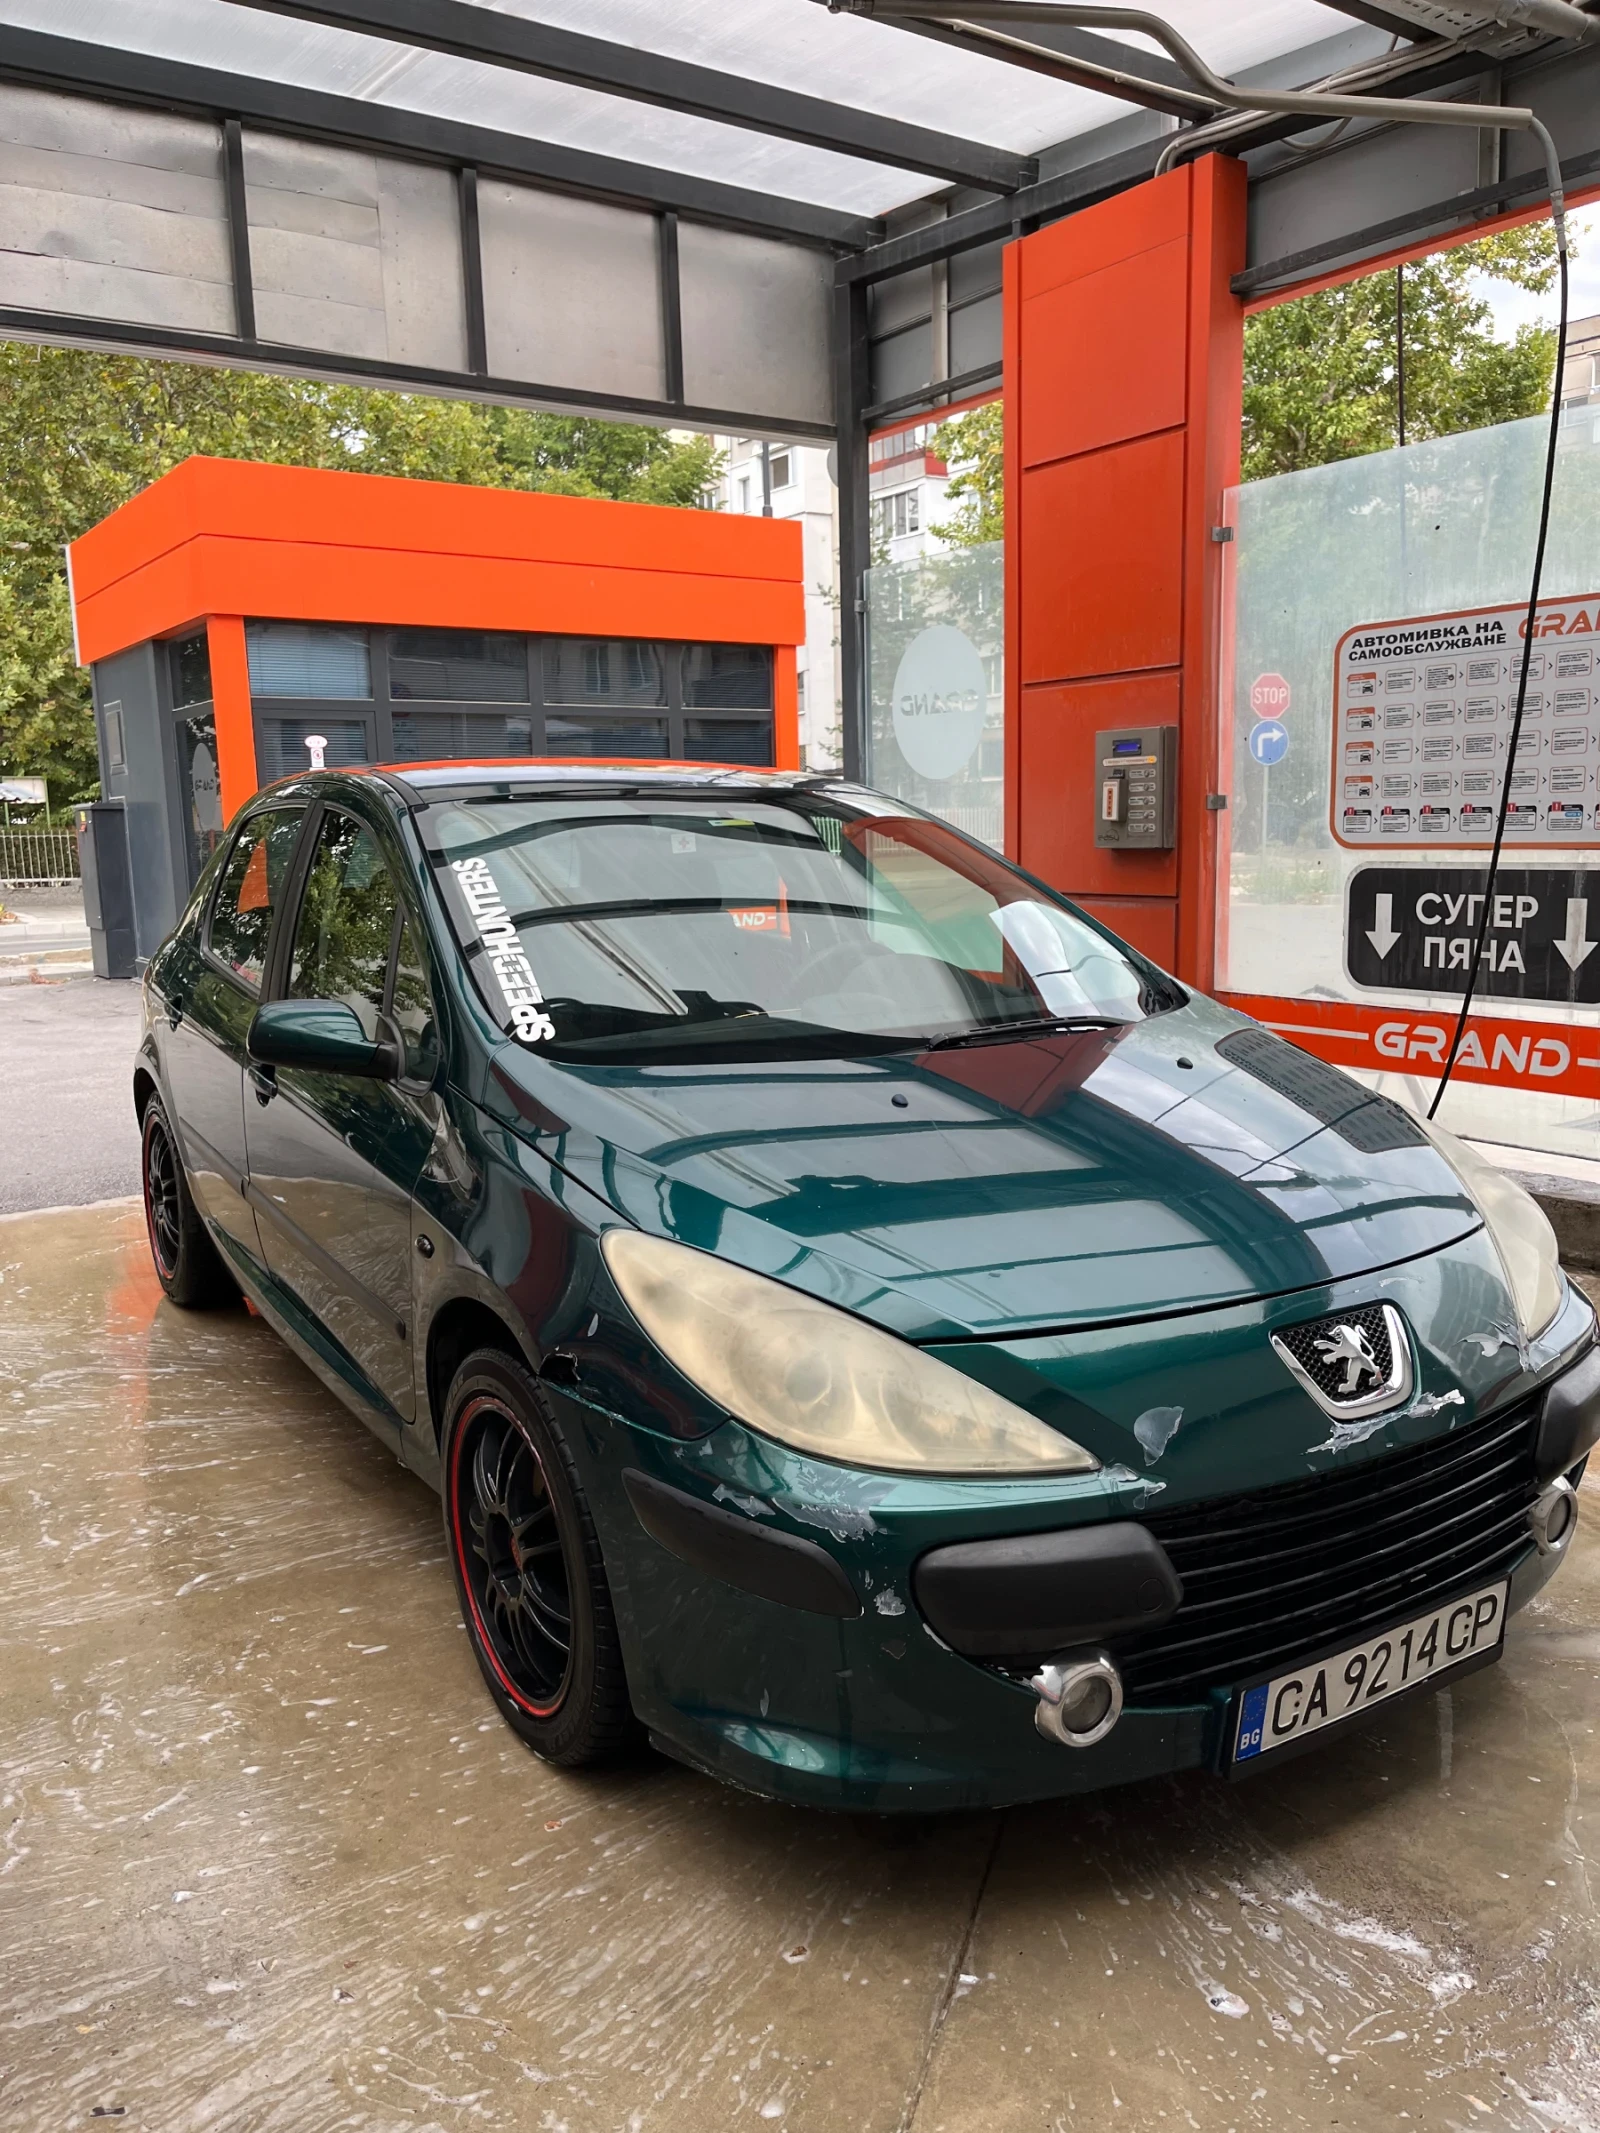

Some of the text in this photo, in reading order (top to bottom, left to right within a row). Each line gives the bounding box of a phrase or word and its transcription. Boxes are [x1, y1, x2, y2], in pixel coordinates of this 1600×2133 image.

[1351, 621, 1503, 649] АВТОМИВКА НА
[1518, 609, 1600, 639] GRA
[1348, 633, 1506, 661] САМООБСЛУЖВАНЕ
[1254, 687, 1287, 704] STOP
[1415, 892, 1539, 929] СУПЕР
[452, 857, 556, 1042] SPEEDHUNTERS
[1423, 936, 1527, 974] ПЯНА
[1374, 1022, 1571, 1077] GRAND
[1271, 1593, 1498, 1736] CA 9214 CP
[1240, 1728, 1261, 1750] BG
